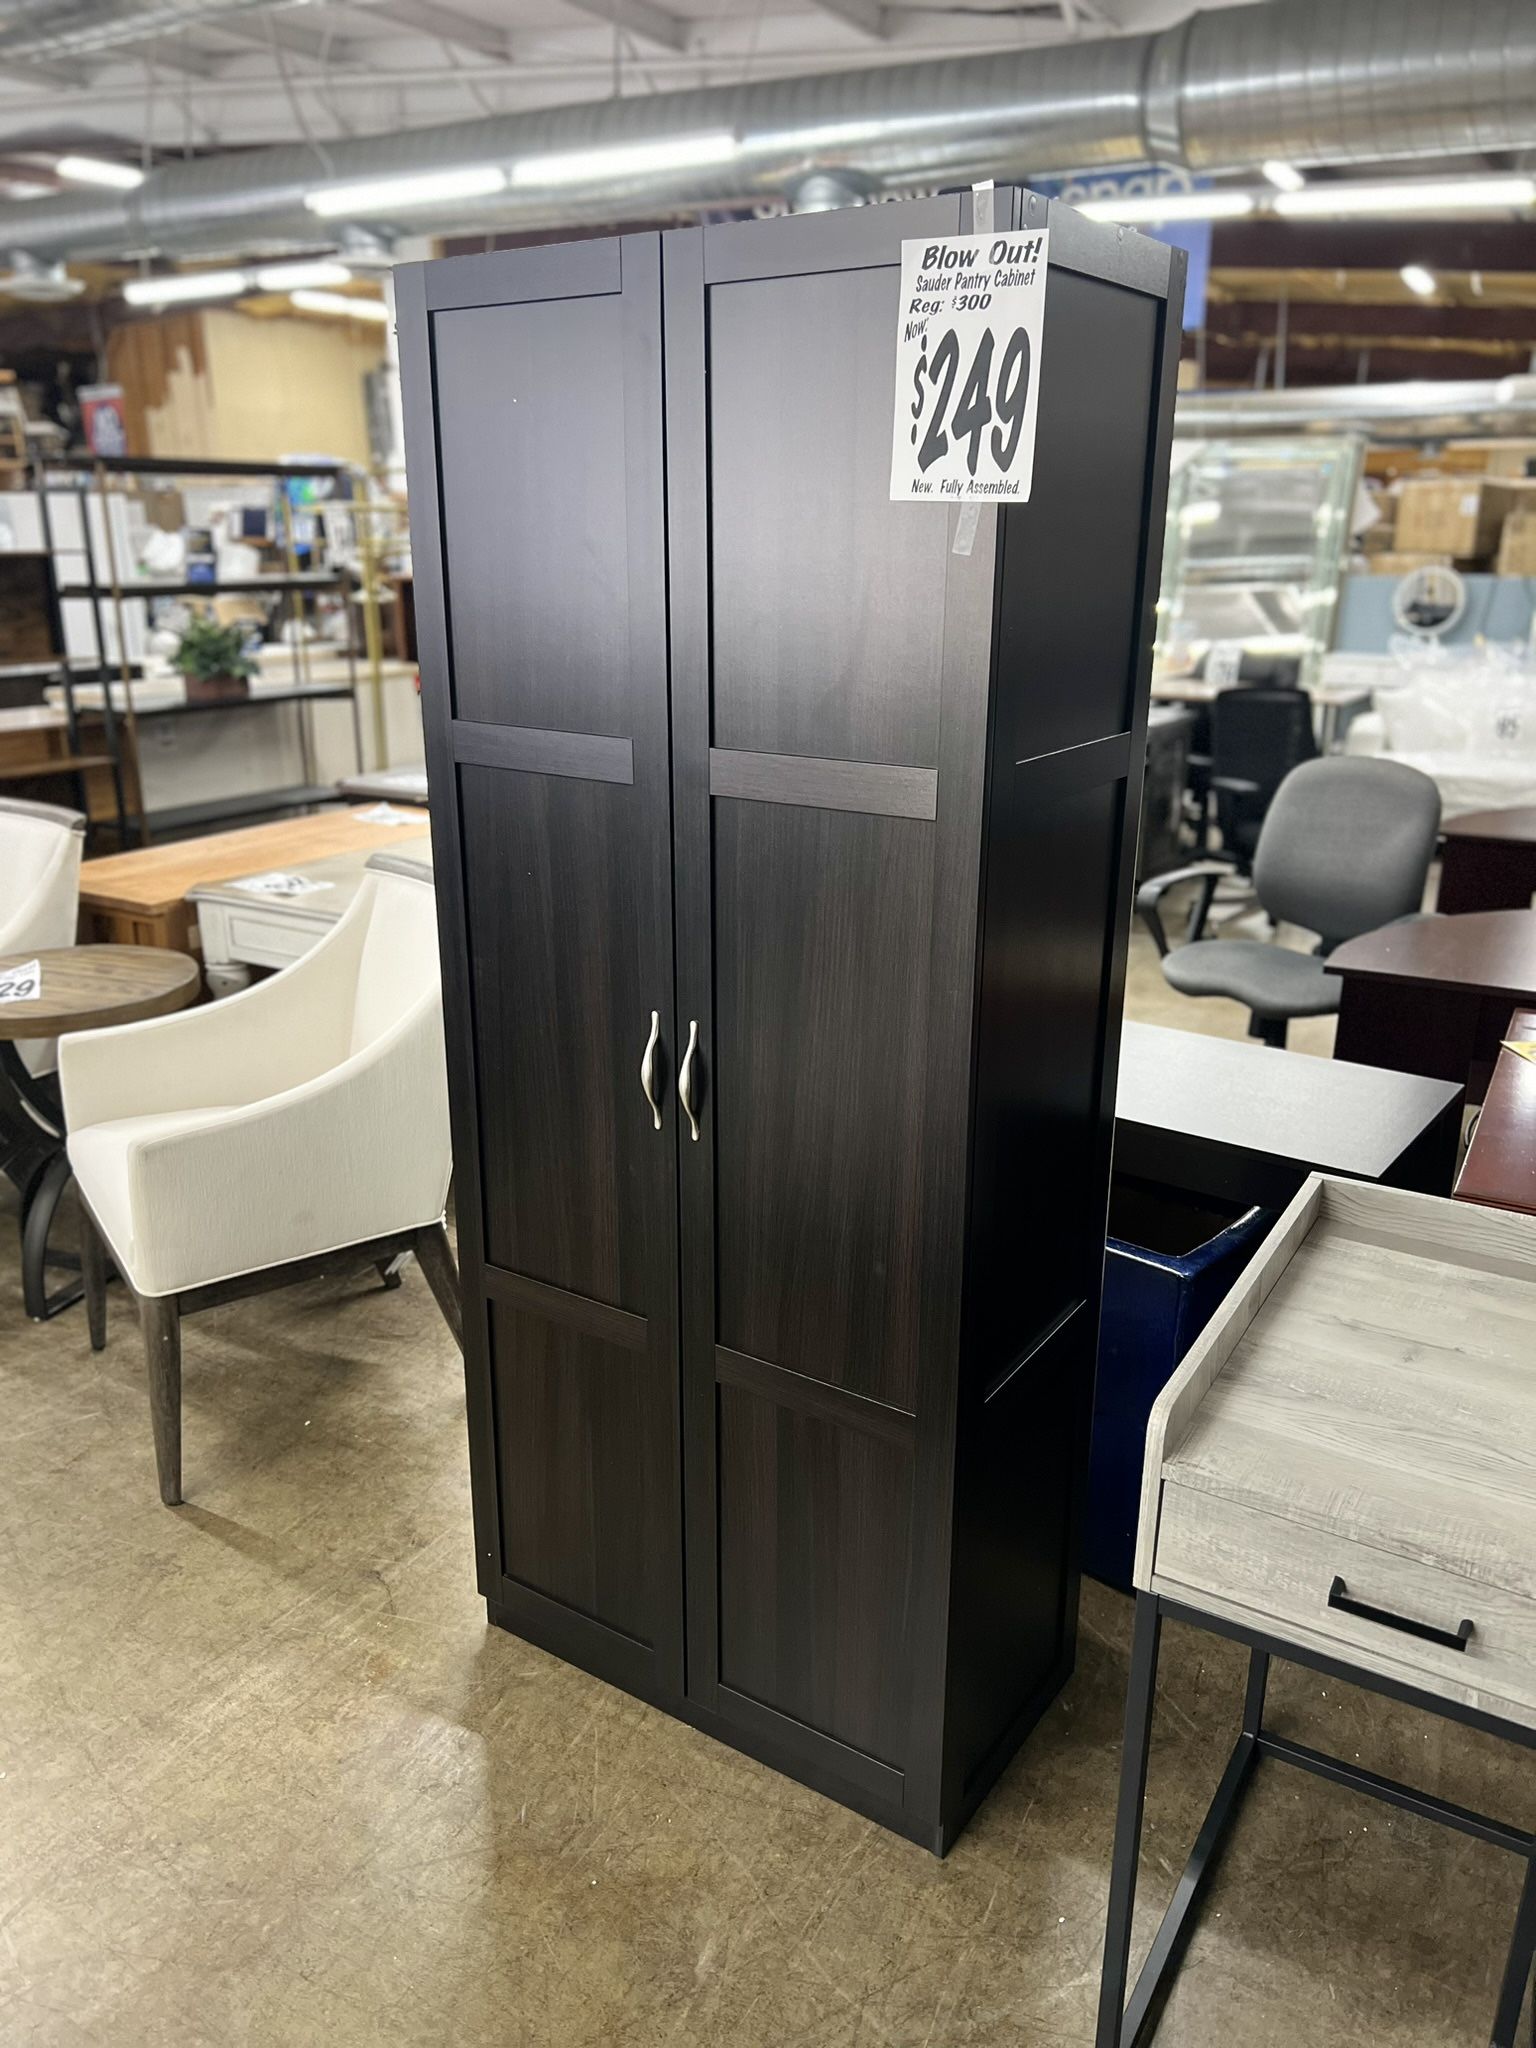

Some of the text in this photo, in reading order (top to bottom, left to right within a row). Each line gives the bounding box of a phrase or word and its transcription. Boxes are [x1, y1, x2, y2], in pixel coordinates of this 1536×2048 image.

[921, 237, 1043, 270] Blow Out!
[915, 268, 1036, 292] Sauder Pantry Cabinet
[909, 293, 992, 315] Reg: $300
[904, 317, 929, 342] Now:
[911, 327, 1031, 476] $249
[911, 478, 1021, 496] New. Fully Assembled.
